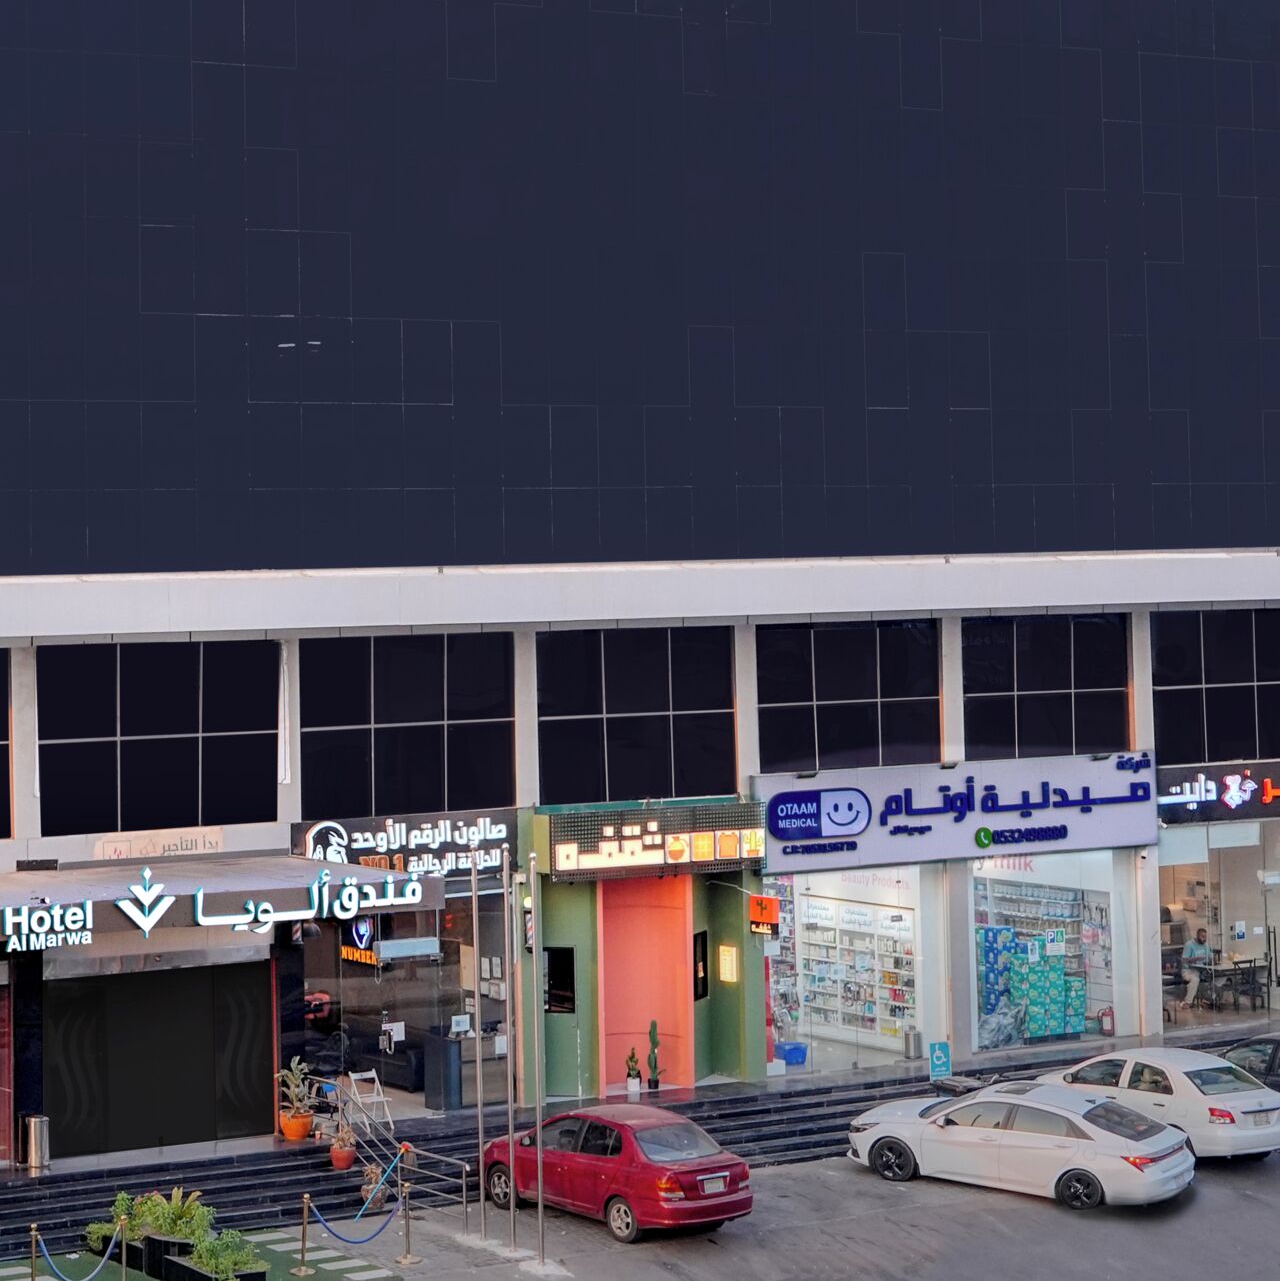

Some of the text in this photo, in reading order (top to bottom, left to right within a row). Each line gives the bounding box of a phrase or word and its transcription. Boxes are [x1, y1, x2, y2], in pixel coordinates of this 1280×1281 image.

[1116, 752, 1152, 774] شركة
[777, 801, 818, 818] OTAAM
[879, 776, 1152, 826] صيدلية أوتام
[351, 817, 507, 853] صالون الرقم الأوحد
[777, 817, 818, 830] MEDICAL
[393, 853, 404, 873] 1
[406, 851, 457, 876] الرجالية
[841, 872, 871, 888] Beauty
[194, 869, 423, 934] فندق ألويا
[2, 900, 94, 936] Hotel
[6, 929, 93, 953] Al Marwa
[1047, 931, 1056, 942] P
